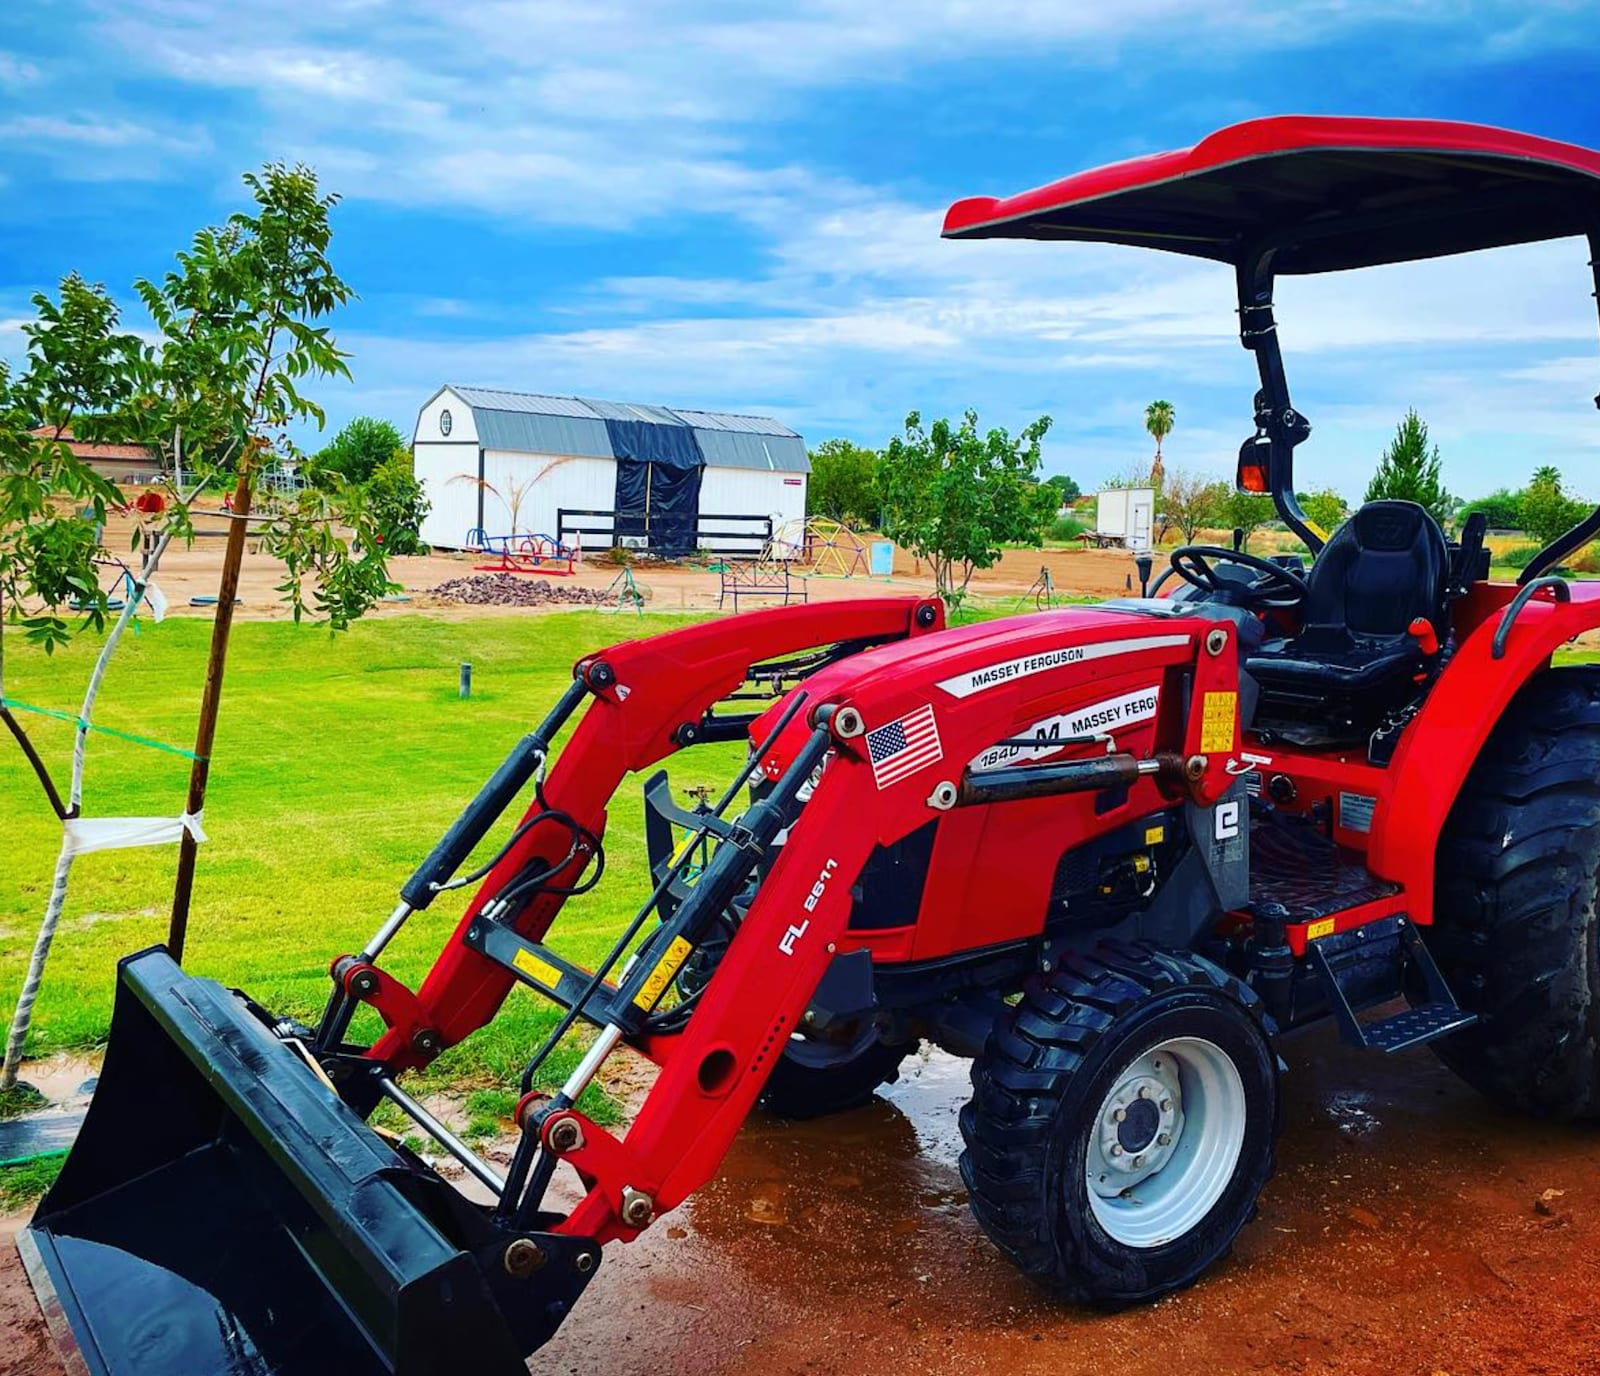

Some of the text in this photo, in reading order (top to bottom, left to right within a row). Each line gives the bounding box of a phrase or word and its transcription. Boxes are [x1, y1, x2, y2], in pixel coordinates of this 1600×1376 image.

[972, 648, 1084, 687] MASSEY FERGUSON
[980, 745, 1020, 767] 1840
[1071, 706, 1121, 734] MASSEY
[778, 858, 838, 956] FL 2611
